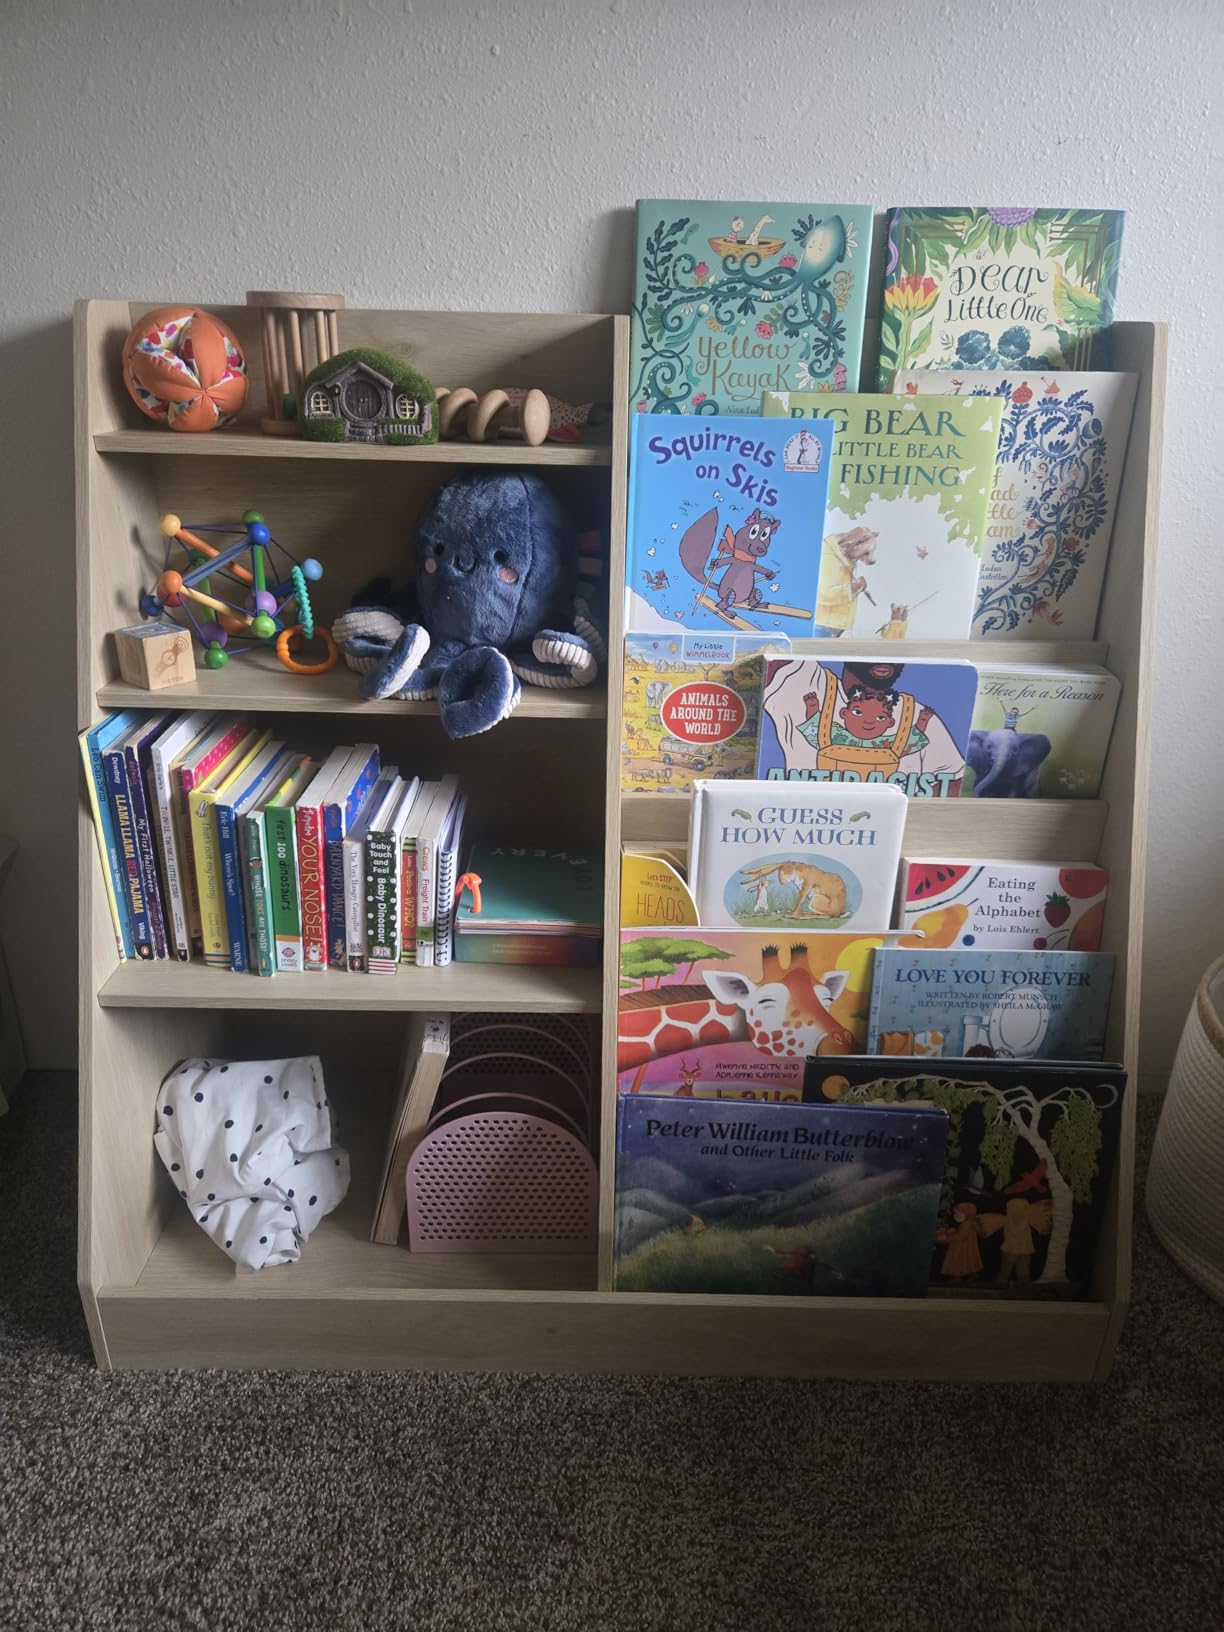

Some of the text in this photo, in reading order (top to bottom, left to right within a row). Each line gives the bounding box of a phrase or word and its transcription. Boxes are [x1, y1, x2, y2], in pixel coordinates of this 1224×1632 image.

[949, 264, 1049, 296] Dear
[944, 295, 1049, 323] Little One
[696, 336, 797, 375] Yellow
[712, 360, 792, 401] Kayak
[864, 409, 967, 437] BEAR
[648, 426, 776, 468] Squirrels
[906, 443, 963, 459] BEAR
[696, 463, 779, 507] on Skis
[840, 463, 961, 487] FISHING
[694, 642, 702, 650] My
[680, 692, 728, 706] ANIMALS
[979, 682, 1104, 701] Here for a Reason
[670, 706, 737, 722] AROUND THE
[684, 722, 720, 736] WORLD
[109, 756, 122, 784] Dewdney
[219, 810, 230, 838] Eric Hill
[758, 807, 843, 825] GUESS
[370, 842, 392, 851] Baby
[720, 827, 877, 846] HOW MUCH
[114, 793, 145, 913] LLAMA LLAMA RED PAJAMA
[136, 817, 155, 893] My First Halloween
[369, 850, 392, 858] Touch
[373, 858, 389, 866] and
[422, 847, 430, 872] Crews
[223, 852, 236, 896] Where's Spot?
[276, 819, 293, 911] first 100 dinosaurs
[327, 840, 342, 889] BARNYARD
[350, 864, 358, 878] Very
[373, 866, 390, 874] Feel
[171, 883, 179, 899] STAR
[254, 874, 262, 896] WHOSE
[300, 835, 322, 942] YOUR NOSE!
[350, 879, 358, 900] Hungry
[987, 877, 1036, 892] Eating
[422, 879, 430, 922] Freight Train
[636, 891, 685, 924] HEADS
[998, 892, 1021, 903] the
[330, 893, 343, 927] DANCE!
[351, 902, 359, 931] Caterpillar
[376, 878, 386, 944] Baby Dinosaur
[405, 897, 415, 928] WHO?
[975, 905, 1041, 918] Alphabet
[136, 922, 147, 940] Viking
[257, 916, 265, 928] ARE
[973, 924, 1039, 934] by Lois Ehlert
[258, 928, 267, 951] THOSE?
[232, 941, 242, 967] WARNE
[896, 968, 1091, 986] LOVE YOU FOREVER
[918, 1000, 977, 1008] ILLUSTRATED
[982, 992, 1016, 1000] ROBERT
[646, 1119, 916, 1150] Peter William Butterblow
[700, 1143, 855, 1162] and Other Little Folk
